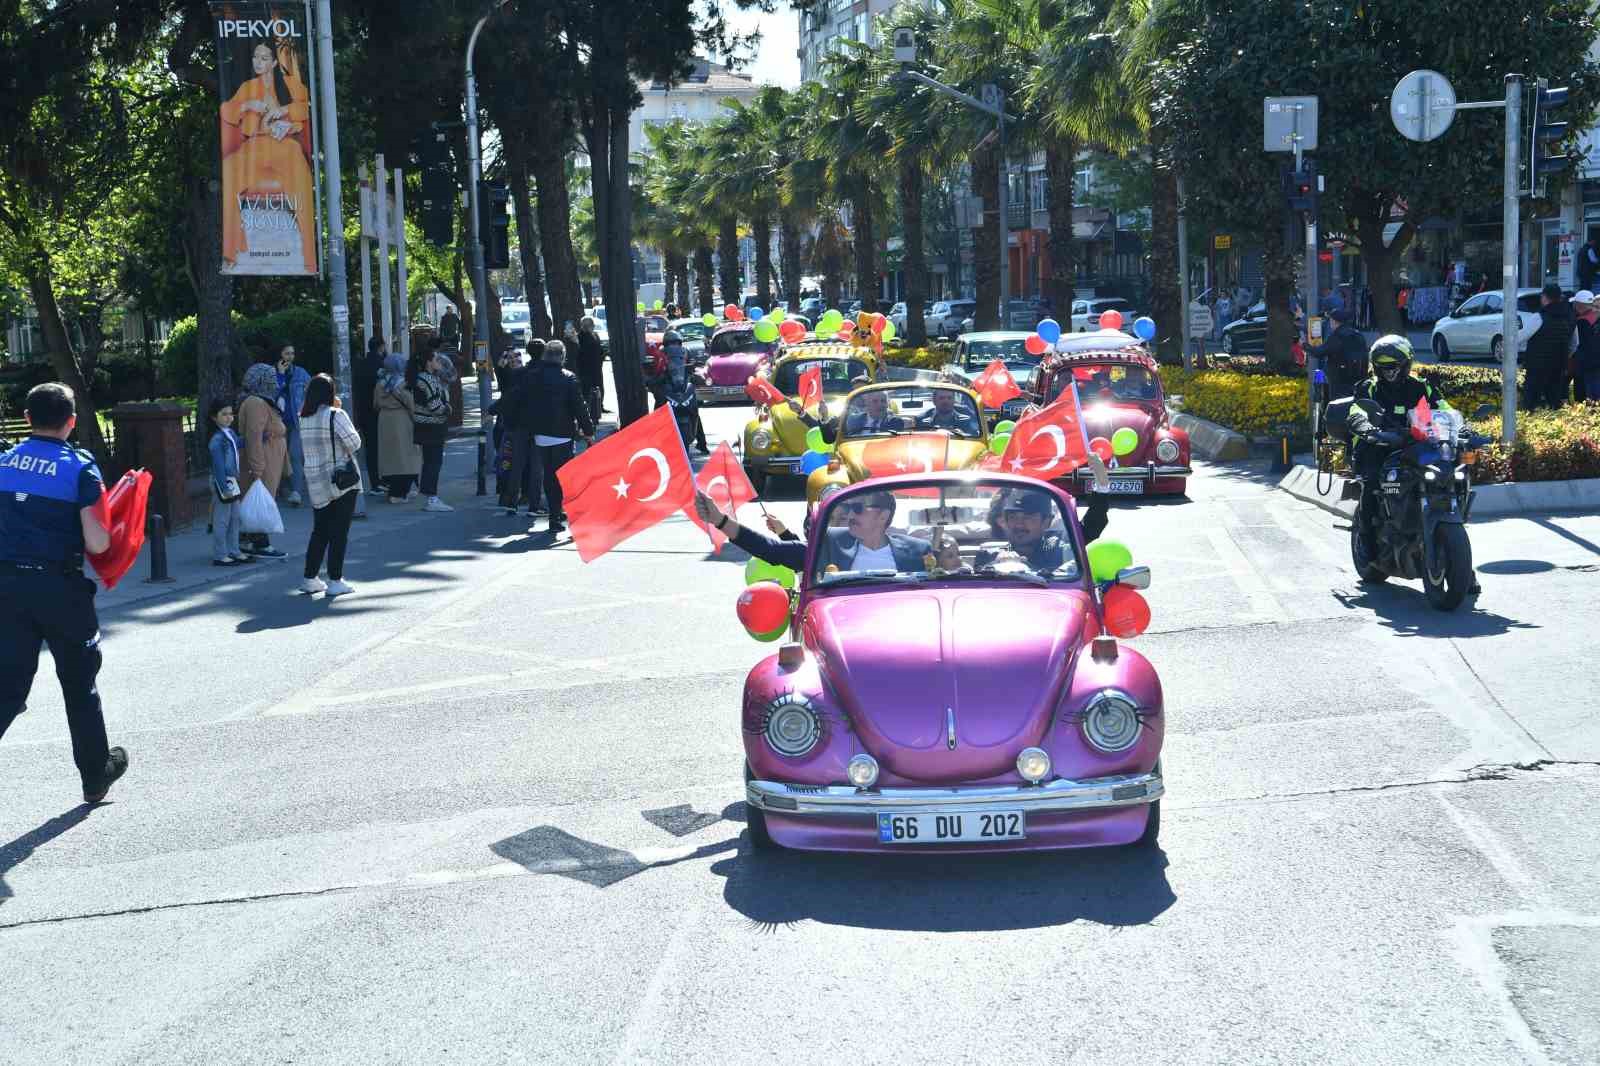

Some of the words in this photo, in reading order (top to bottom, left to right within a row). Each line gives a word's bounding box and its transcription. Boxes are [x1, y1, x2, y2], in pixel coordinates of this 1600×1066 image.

[218, 19, 302, 38] IPEKYOL
[892, 816, 919, 840] 66
[935, 815, 962, 839] DU
[980, 813, 1020, 837] 202
